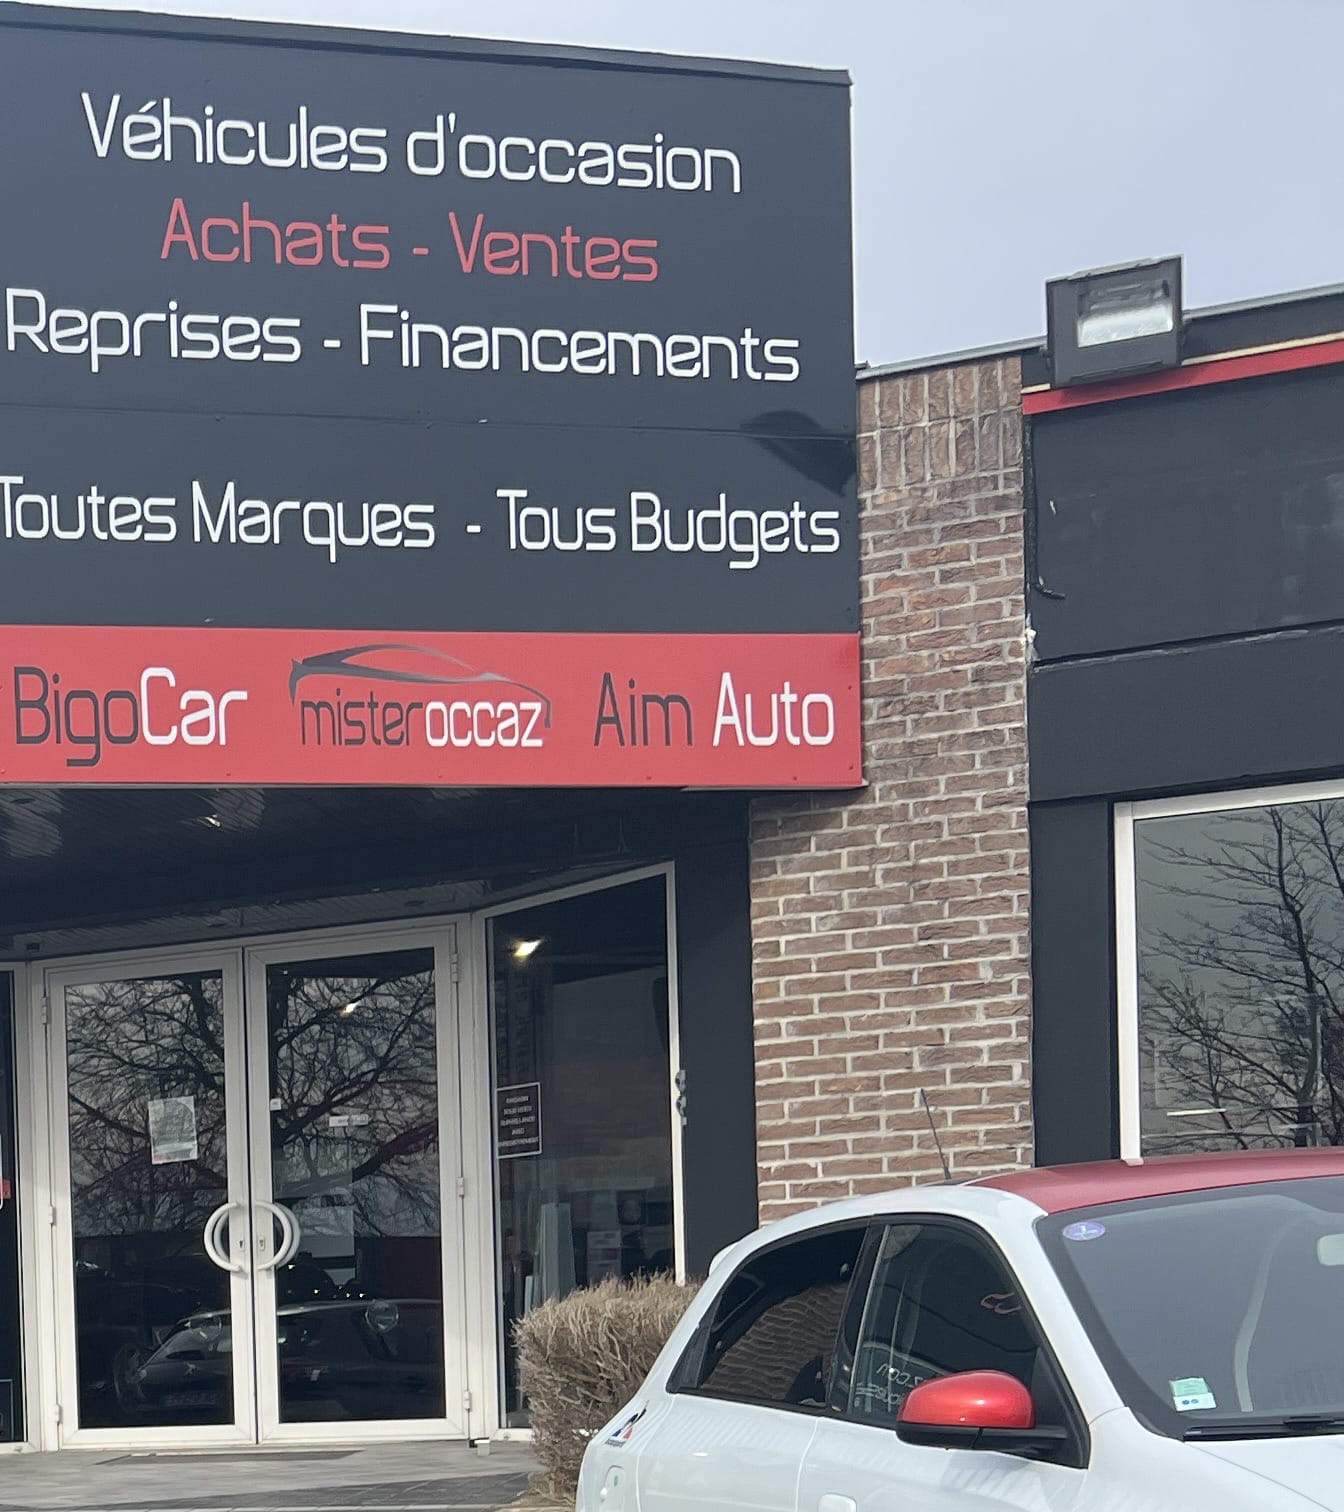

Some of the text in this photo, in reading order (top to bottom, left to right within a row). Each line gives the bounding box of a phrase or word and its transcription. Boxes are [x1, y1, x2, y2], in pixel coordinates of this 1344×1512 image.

[81, 92, 742, 193] Véhicules d'occasion
[160, 198, 390, 270] Achats
[448, 212, 659, 282] Ventes
[6, 288, 302, 372] Reprises
[360, 305, 801, 382] Financements
[193, 481, 435, 562] Marques
[497, 489, 617, 554] Tous
[631, 492, 841, 569] Budgets
[14, 667, 249, 768] BigoCar
[593, 673, 692, 748] Aim
[712, 673, 835, 747] Auto
